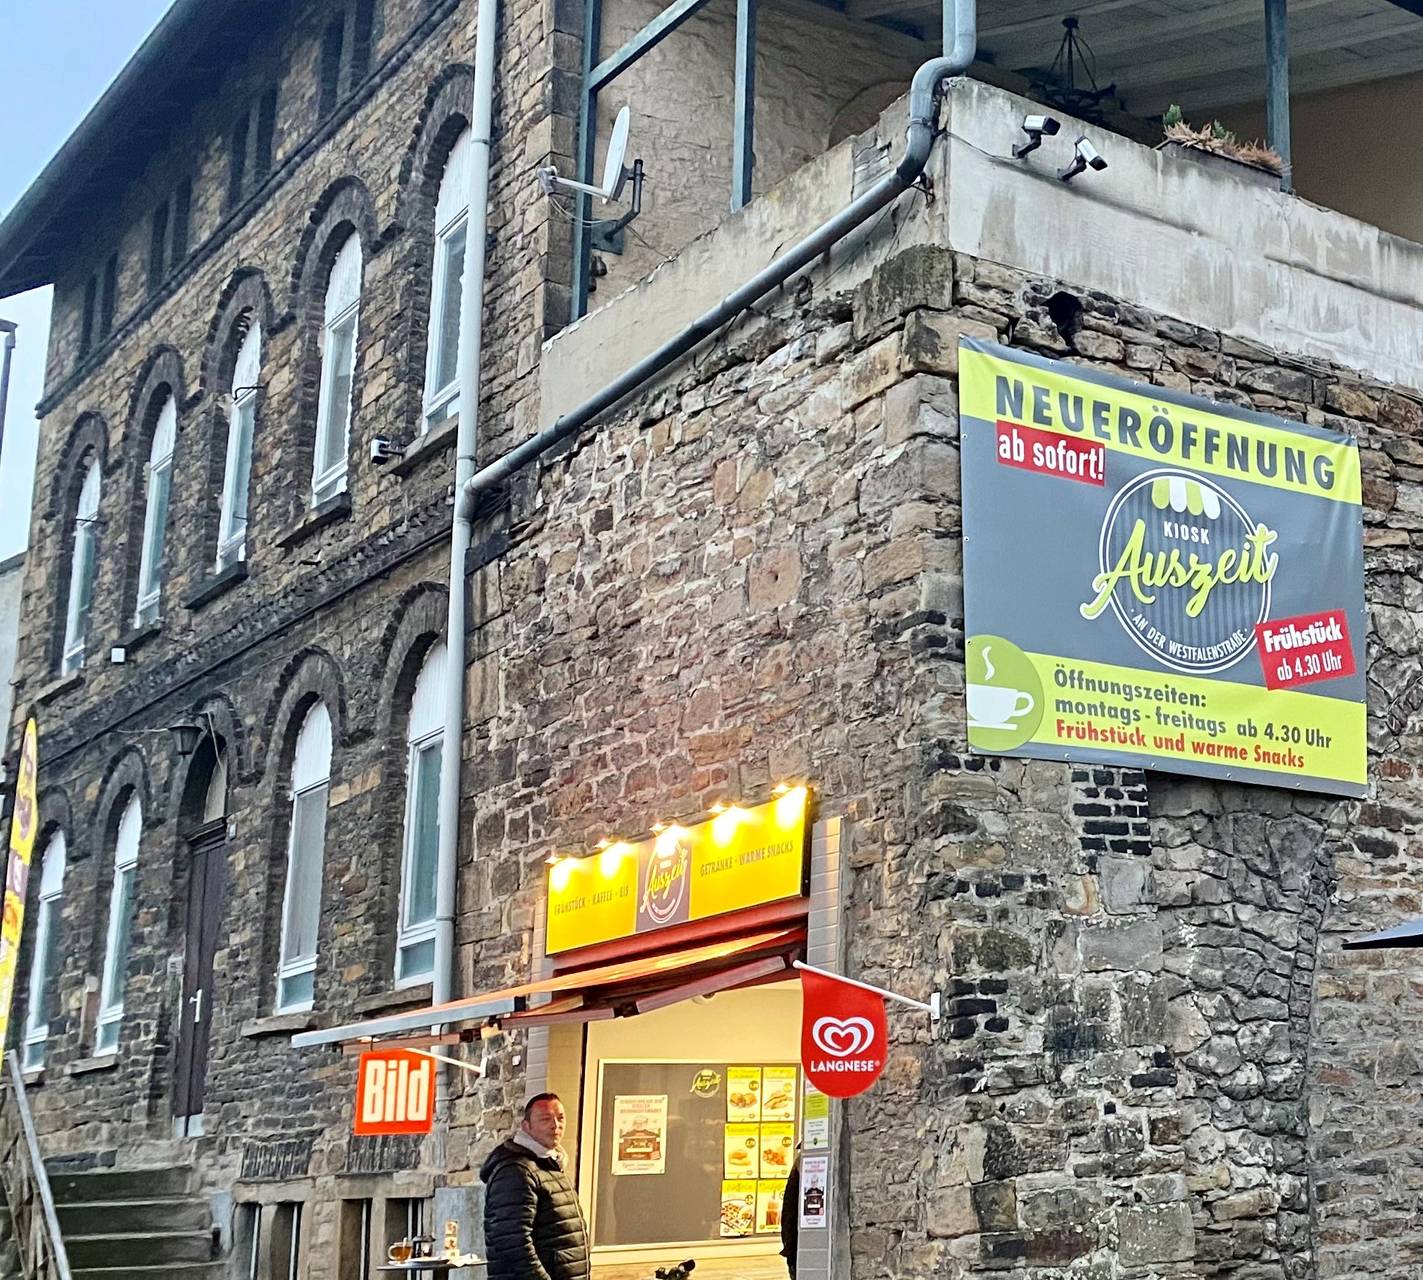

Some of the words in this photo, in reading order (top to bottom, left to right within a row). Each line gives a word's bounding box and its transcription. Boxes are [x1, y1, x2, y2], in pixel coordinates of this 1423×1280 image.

[996, 375, 1335, 490] NEUERÖFFNUNG
[998, 434, 1025, 462] ab
[1033, 439, 1105, 480] sofort!
[1164, 521, 1210, 544] KIOSK
[1080, 518, 1279, 620] Auszeit
[1132, 613, 1149, 631] AN
[1147, 628, 1166, 649] DER
[1263, 618, 1343, 653] Frühstück
[1054, 663, 1207, 707] Öffnungszeiten:
[1277, 658, 1292, 680] ab
[1294, 655, 1321, 677] 4.30
[1322, 651, 1342, 671] Uhr
[1055, 698, 1141, 724] montags
[1155, 707, 1226, 737] freitags
[1237, 718, 1258, 738] ab
[1264, 722, 1301, 744] 4.30
[1305, 727, 1332, 748] Uhr
[1056, 719, 1147, 747] Frühstück
[1153, 734, 1185, 754] und
[1191, 743, 1248, 762] warme
[1254, 744, 1305, 768] Snacks
[767, 840, 794, 859] SNACKS
[810, 1060, 874, 1072] LANGNESE
[362, 1059, 430, 1123] Bild
